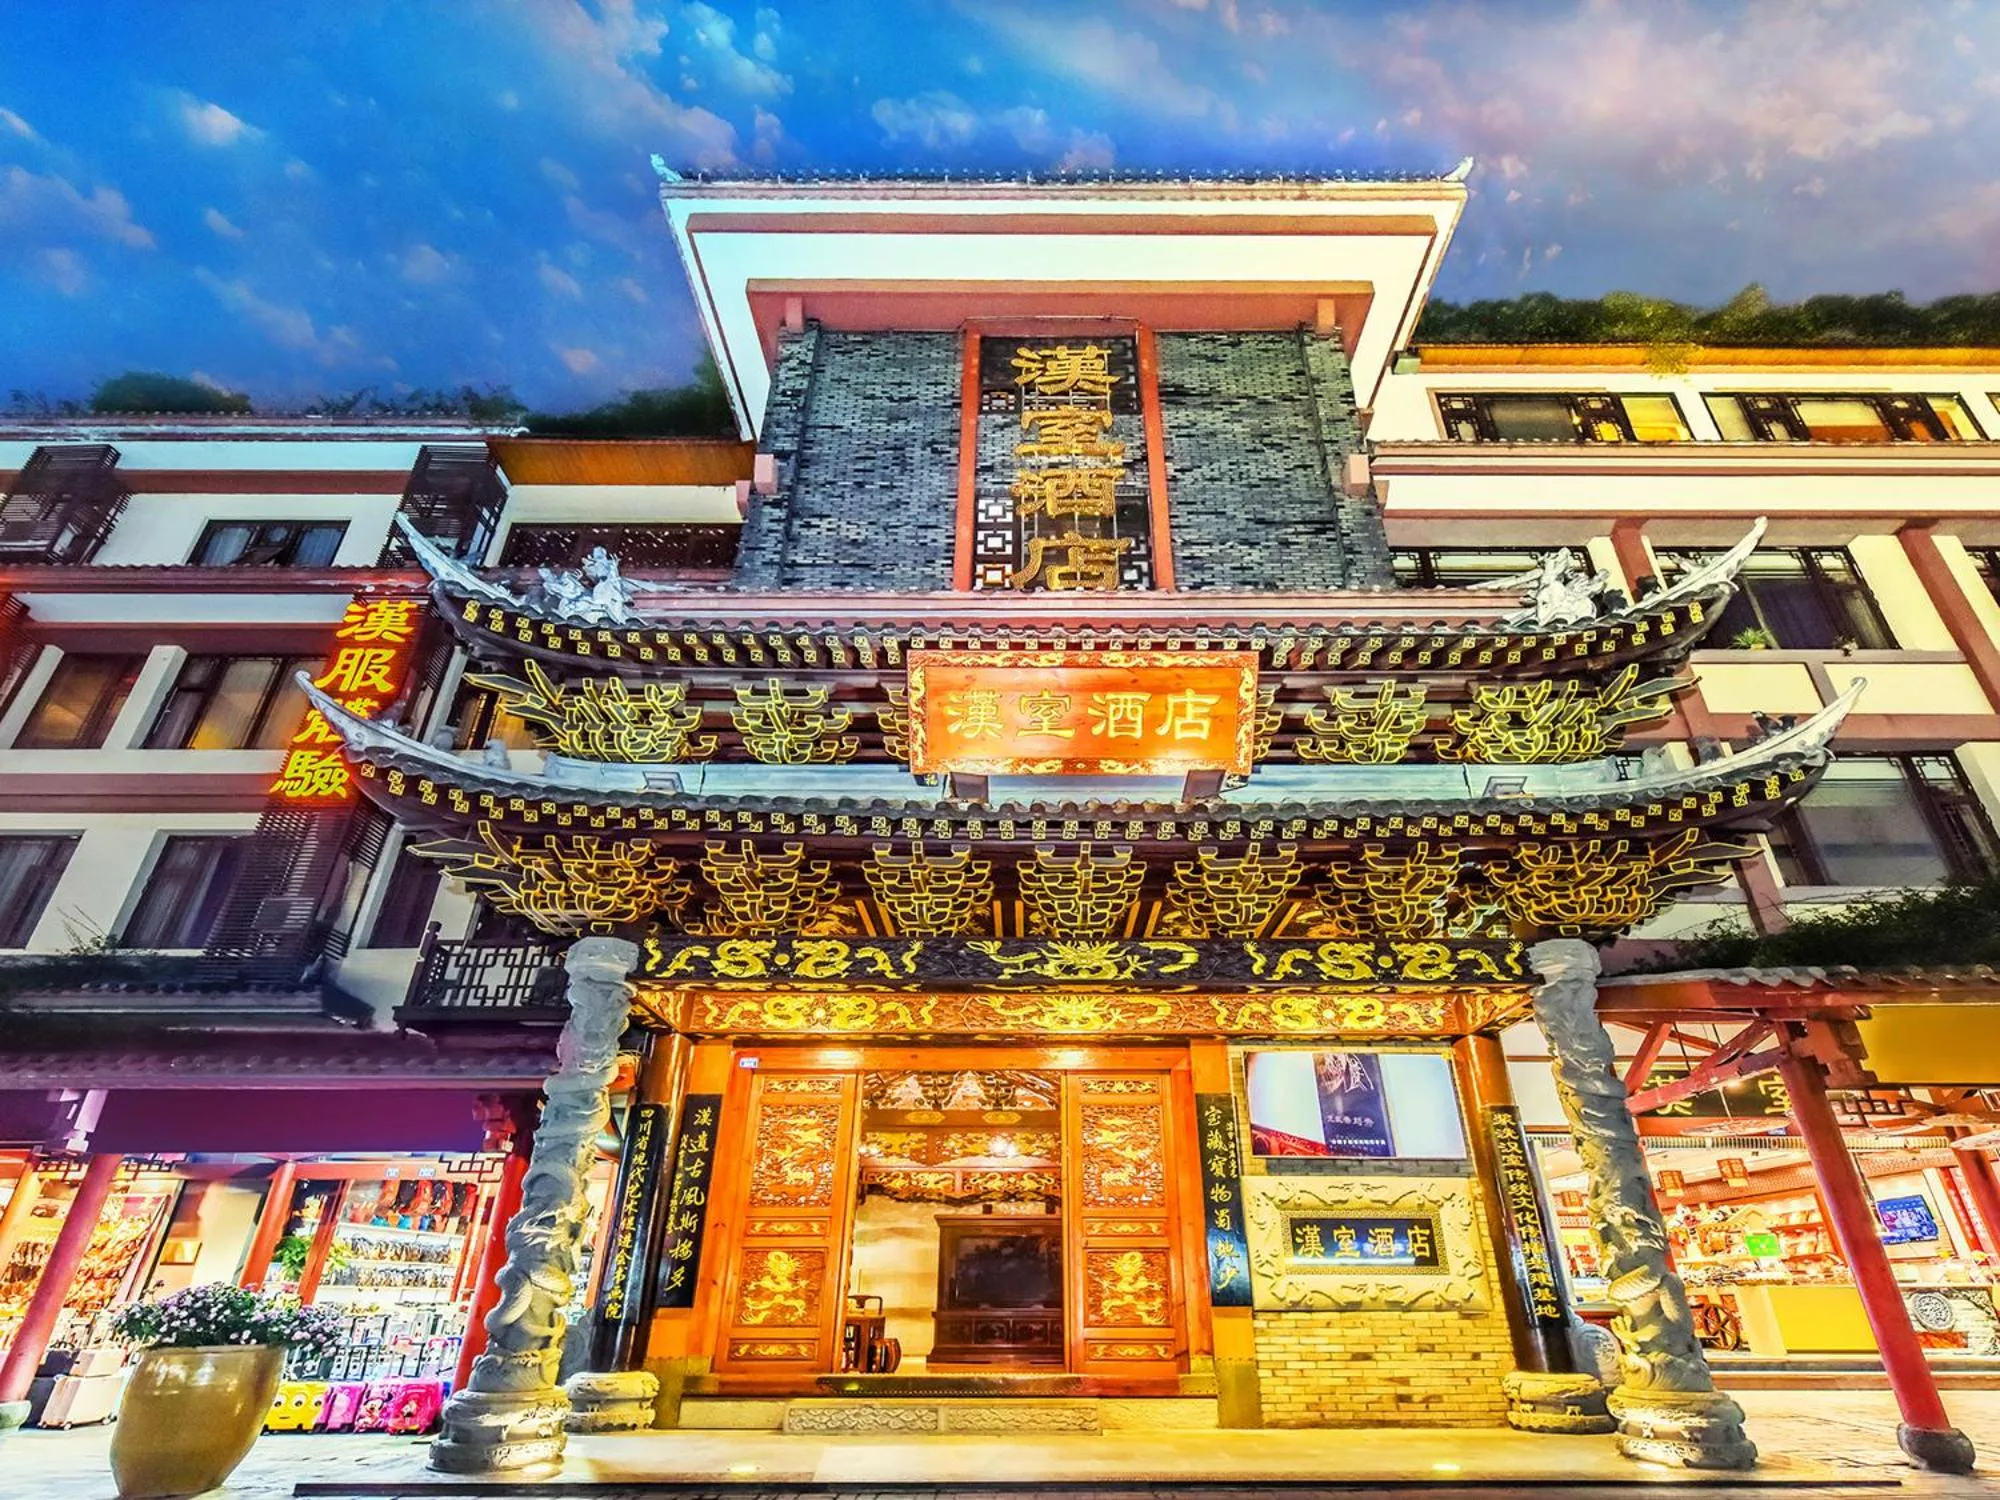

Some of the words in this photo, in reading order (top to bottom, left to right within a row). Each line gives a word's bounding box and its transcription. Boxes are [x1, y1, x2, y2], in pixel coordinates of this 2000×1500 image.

[945, 688, 1221, 741] 漢室酒店
[1295, 1225, 1432, 1259] 漢室酒店
